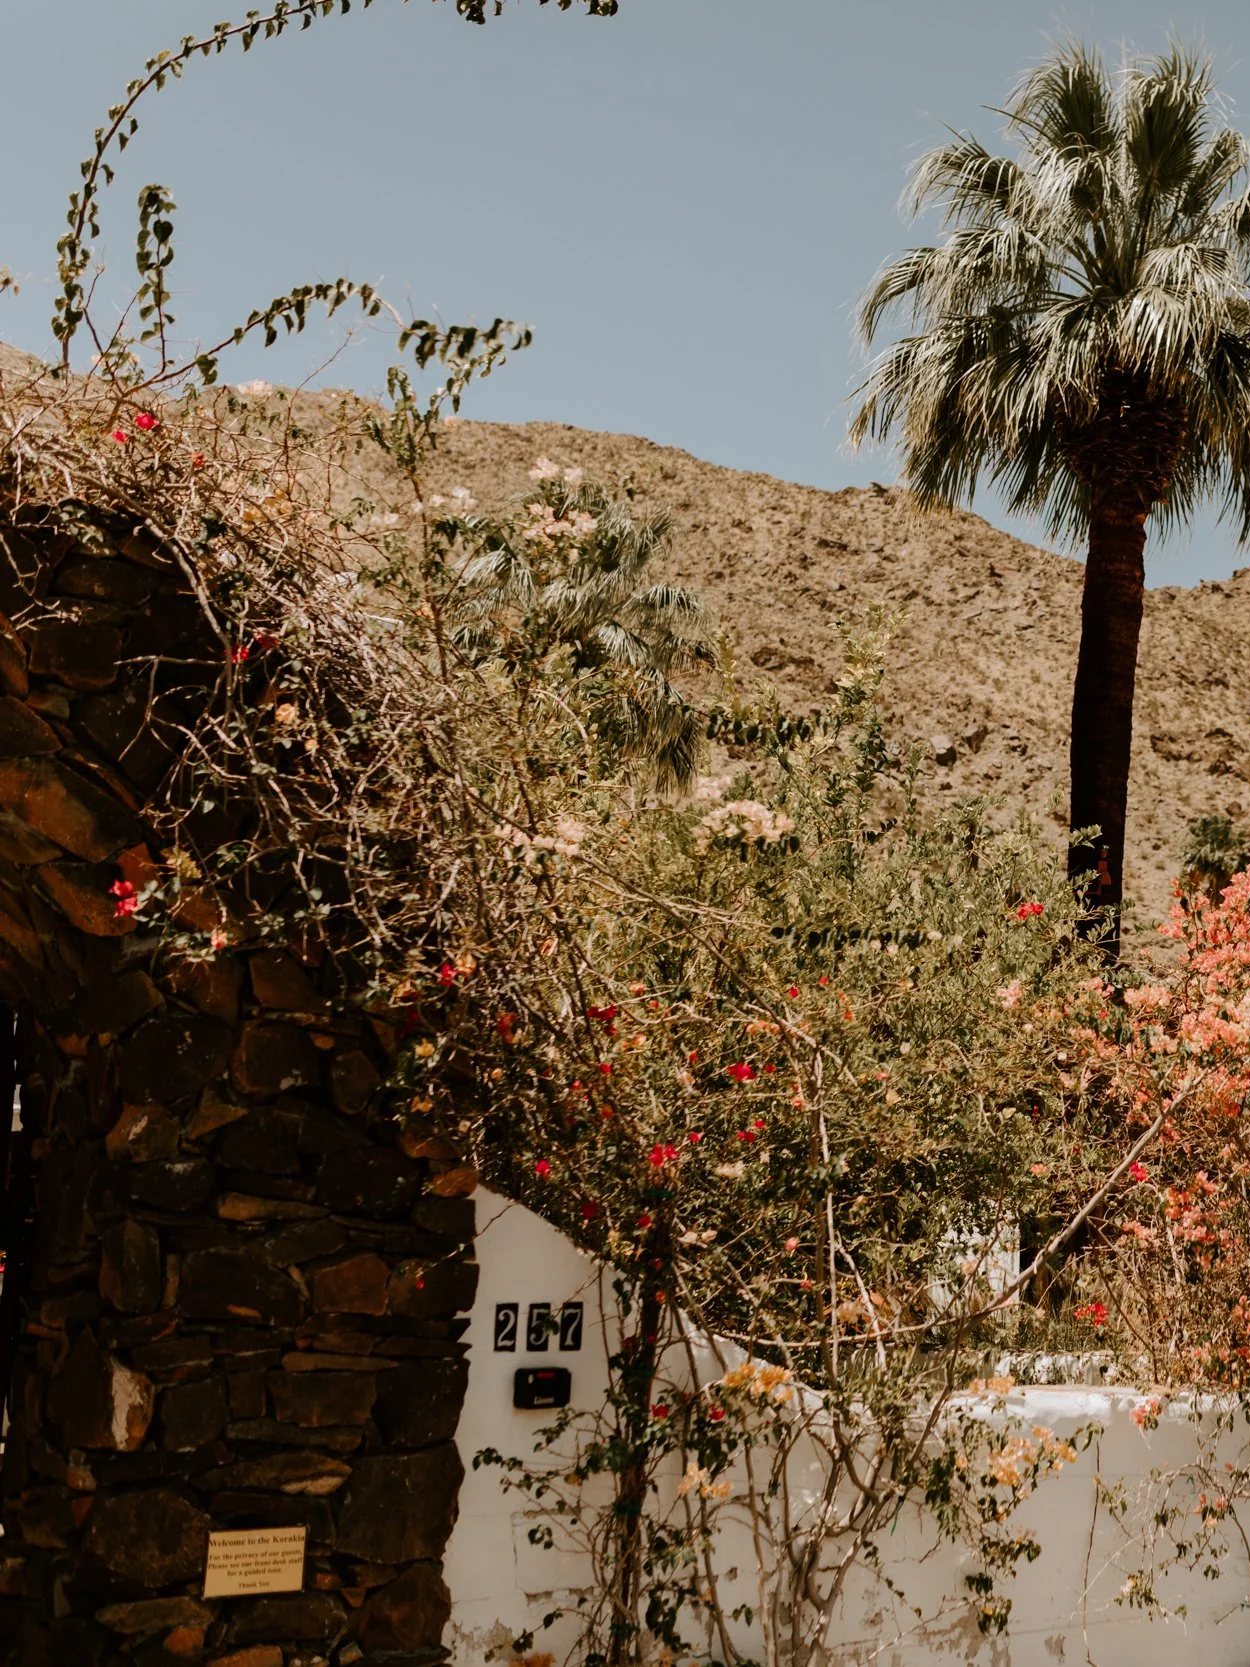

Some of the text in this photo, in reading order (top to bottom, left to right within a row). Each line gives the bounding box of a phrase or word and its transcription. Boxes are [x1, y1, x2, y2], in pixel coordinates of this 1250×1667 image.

[496, 1308, 581, 1348] 257
[209, 1534, 305, 1547] Welcome to the Korakia
[234, 1553, 258, 1561] privacy
[244, 1568, 266, 1577] guided
